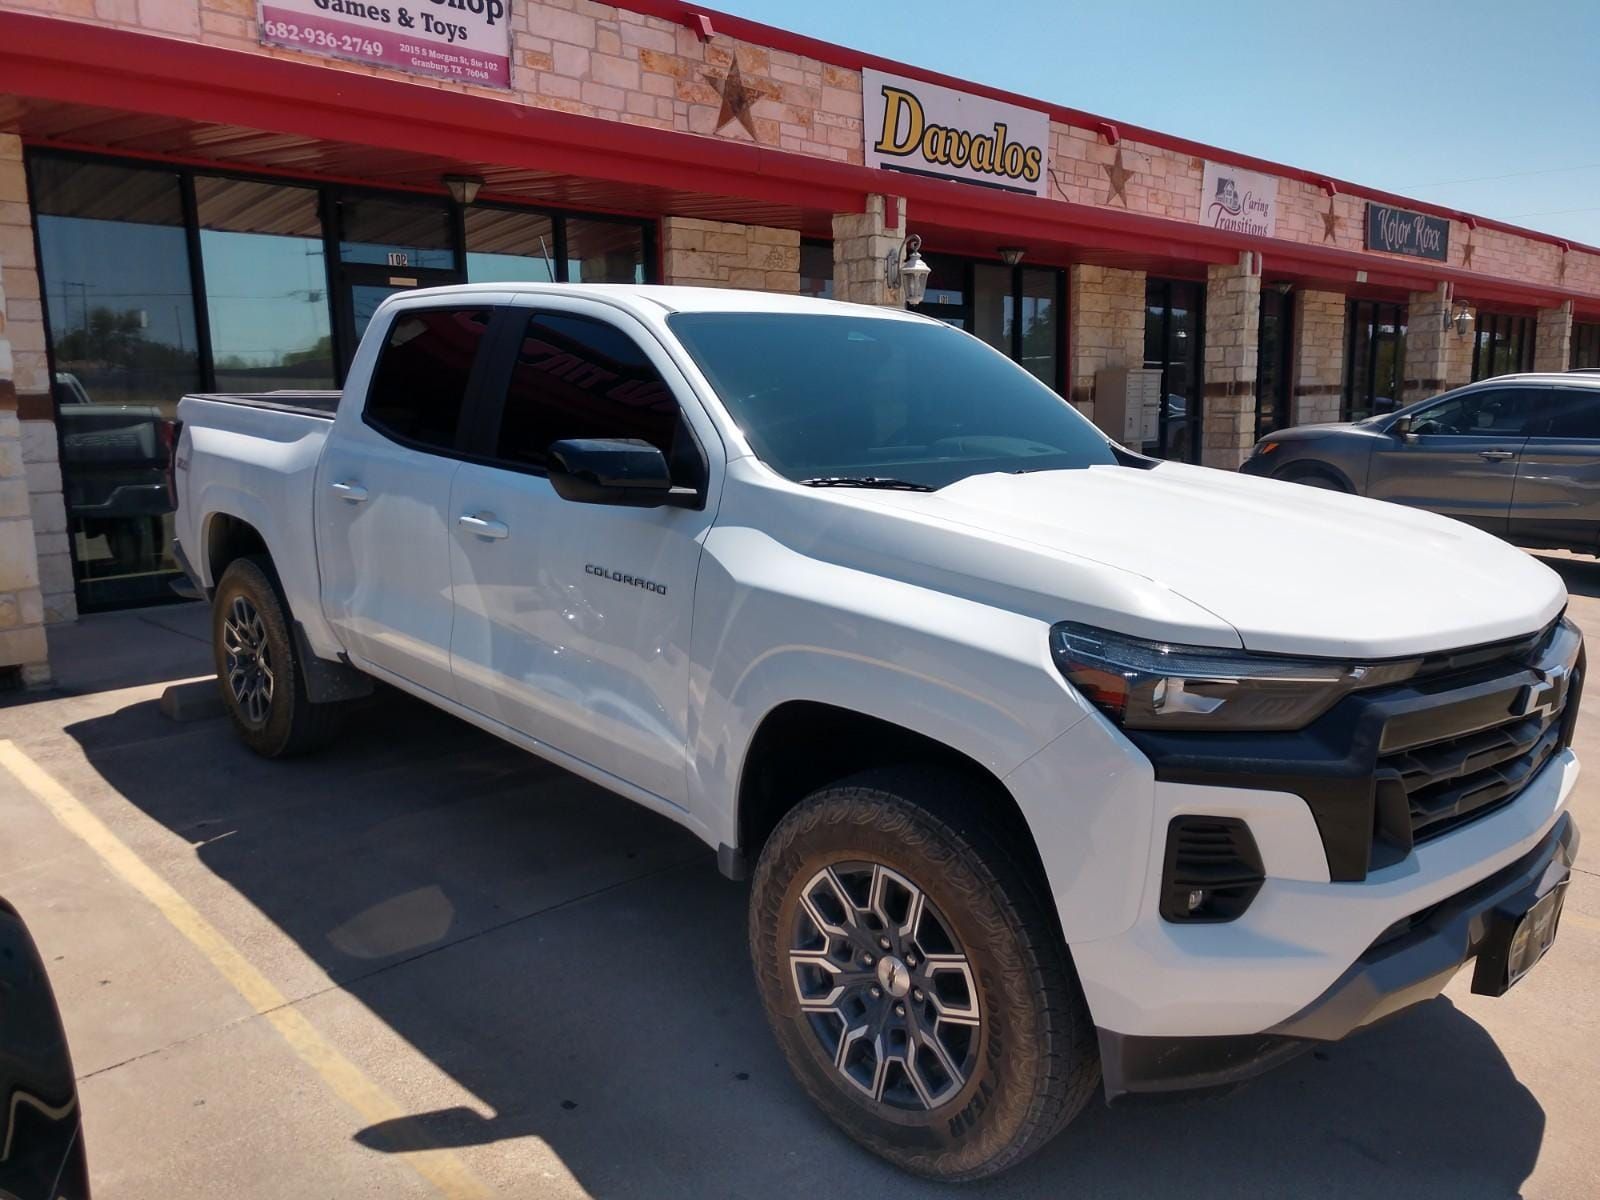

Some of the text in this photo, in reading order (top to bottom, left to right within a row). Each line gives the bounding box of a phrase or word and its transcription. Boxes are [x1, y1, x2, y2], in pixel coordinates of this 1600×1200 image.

[398, 8, 414, 28] &
[420, 13, 468, 42] Toys
[431, 0, 504, 25] op
[264, 20, 384, 57] 682-936-2749
[399, 44, 420, 55] 2015
[421, 48, 428, 56] S
[429, 49, 459, 63] Morgan
[484, 61, 498, 71] 102
[411, 58, 449, 73] Granbury,
[450, 65, 463, 74] TX
[874, 85, 1042, 183] Davalos
[1207, 202, 1269, 237] Transitions
[1242, 190, 1270, 217] Caring
[1378, 208, 1441, 253] Kolor Roxx
[389, 253, 407, 267] 102
[584, 563, 667, 596] COLORADO
